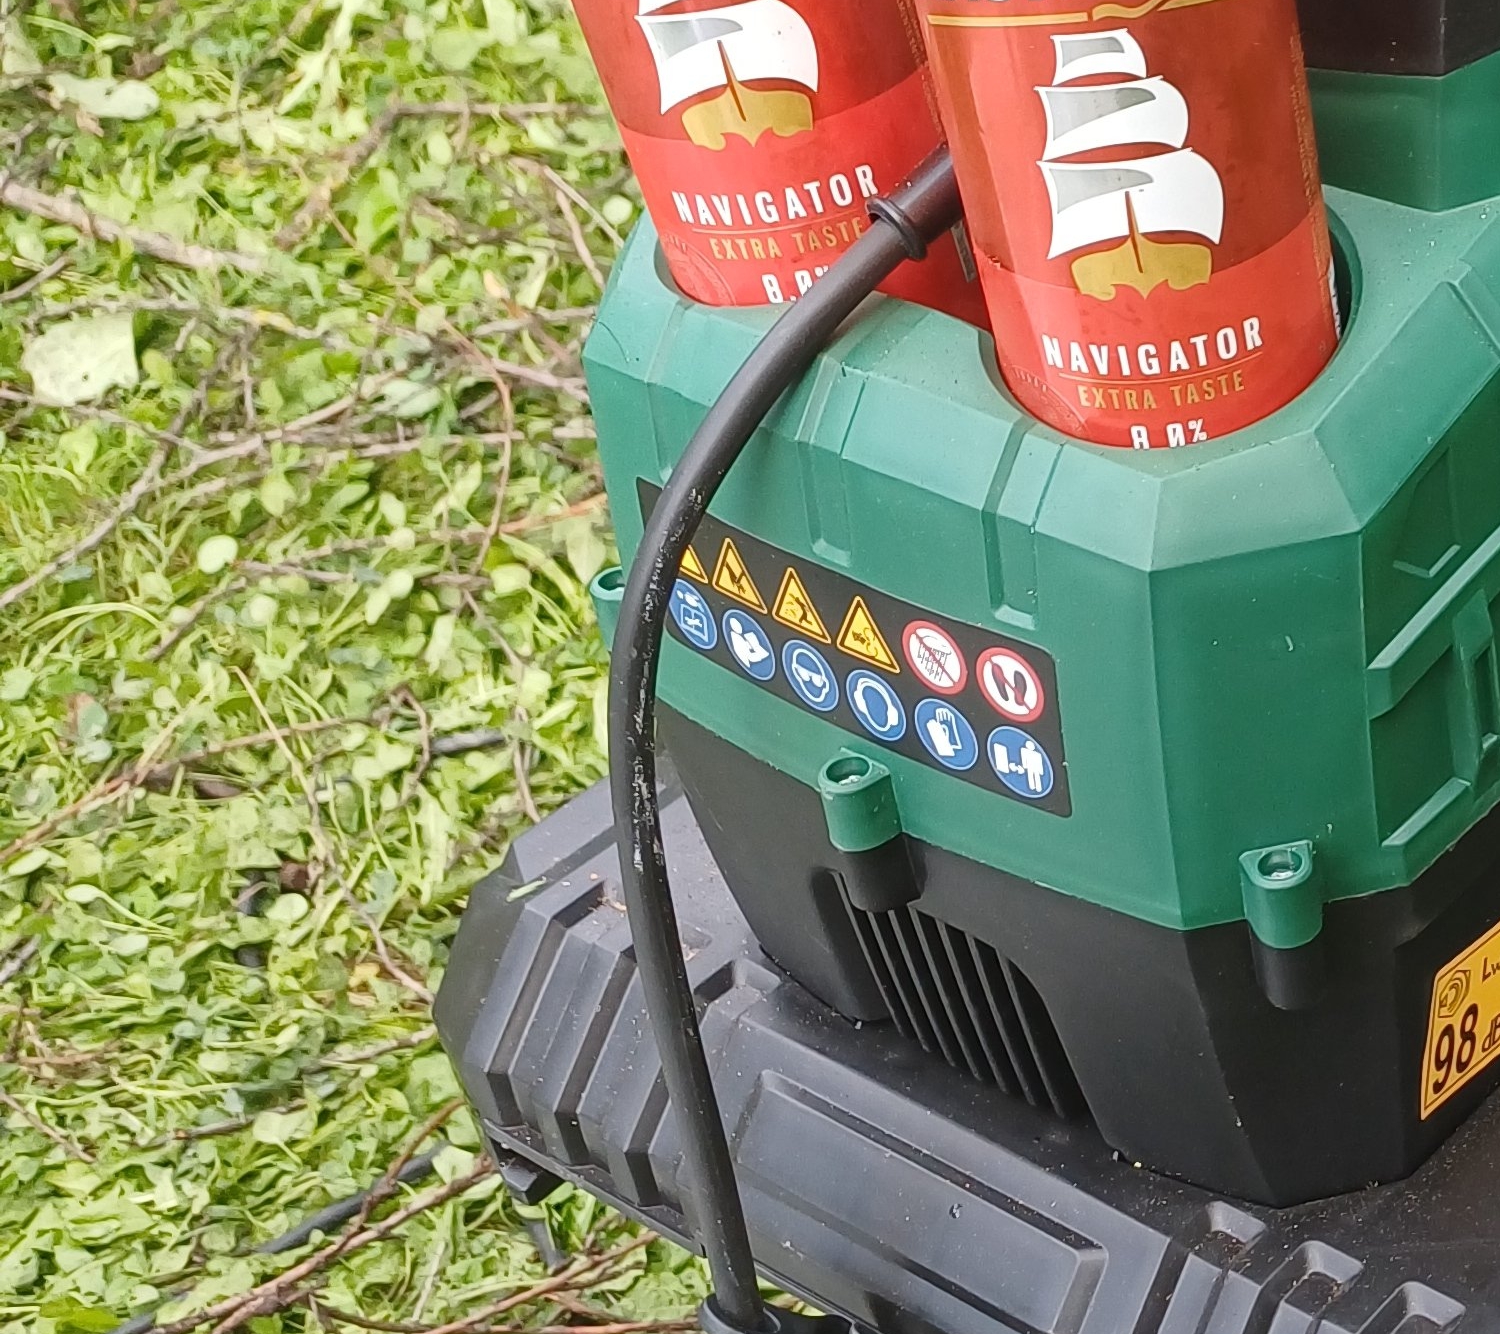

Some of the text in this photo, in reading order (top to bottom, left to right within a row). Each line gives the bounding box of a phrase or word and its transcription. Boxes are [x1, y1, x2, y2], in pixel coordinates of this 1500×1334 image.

[671, 164, 879, 227] NAVIGATOR
[709, 216, 865, 260] EXTRA TASTE
[1041, 316, 1264, 377] NAVIGATOR
[1077, 369, 1245, 411] EXTRA TASTE
[1130, 418, 1208, 450] 80%
[1432, 1003, 1479, 1095] 98
